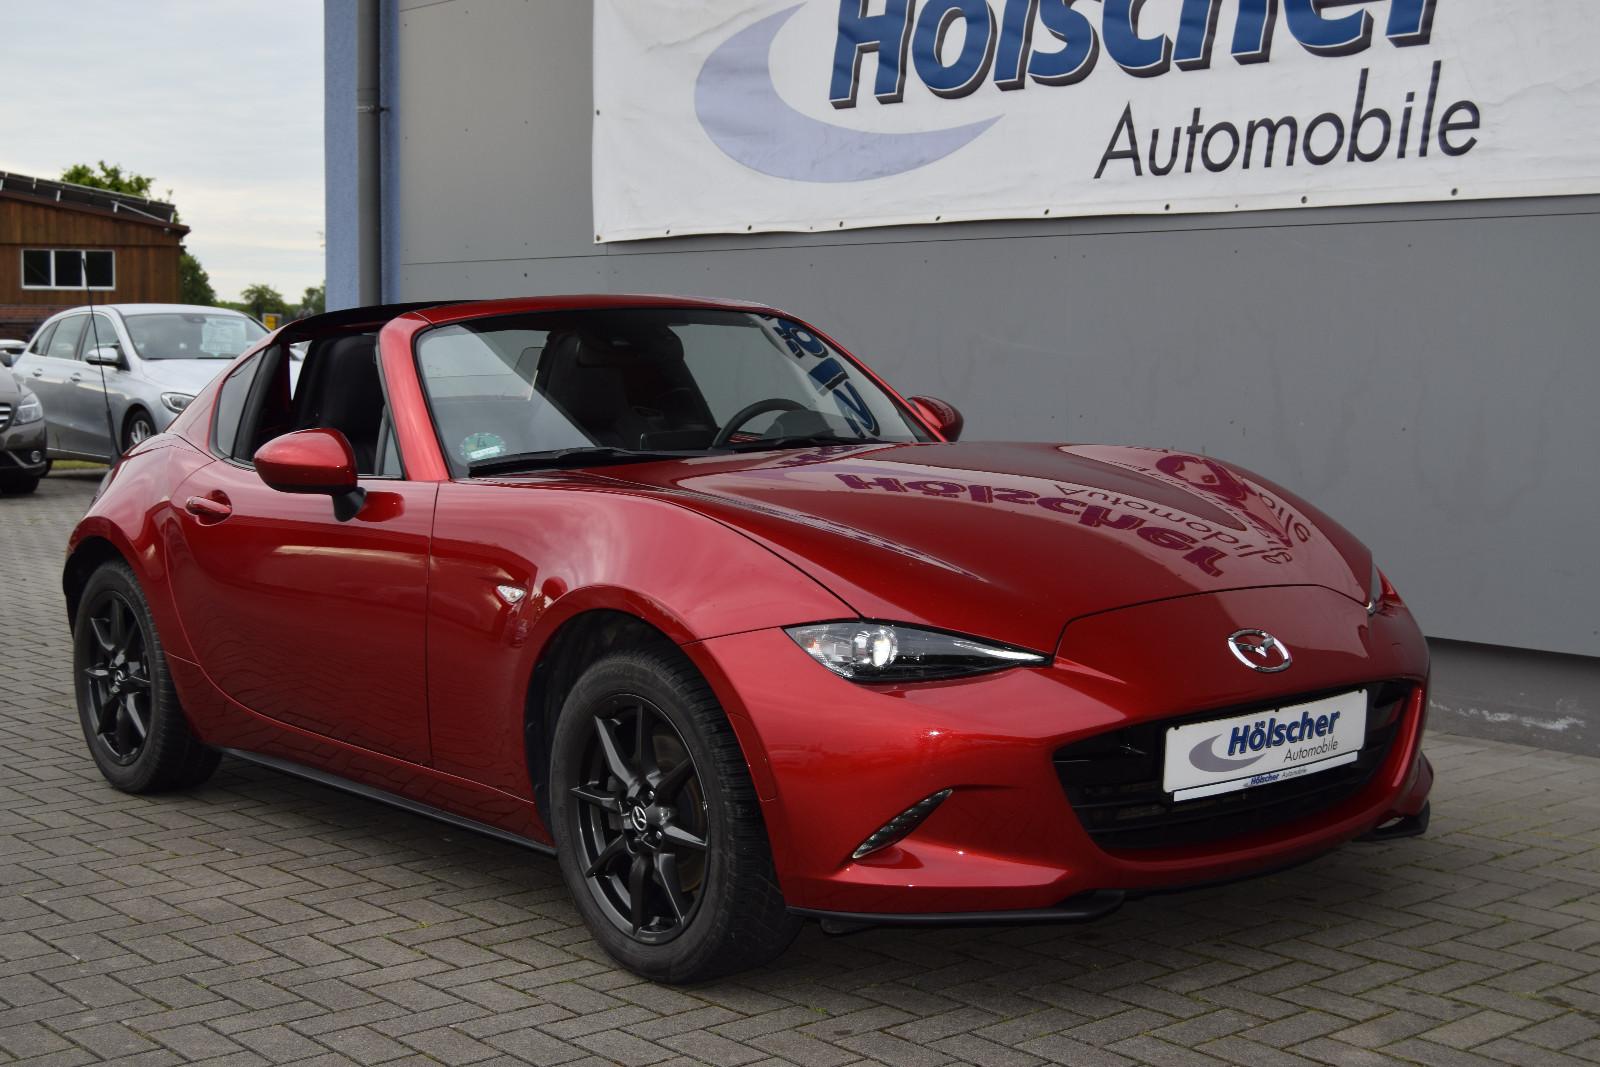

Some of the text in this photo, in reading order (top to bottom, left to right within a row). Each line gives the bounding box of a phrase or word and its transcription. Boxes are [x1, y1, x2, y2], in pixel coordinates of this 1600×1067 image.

[1093, 60, 1480, 179] Automobile
[1228, 711, 1340, 756] Hölscher
[1283, 736, 1338, 762] Automobile
